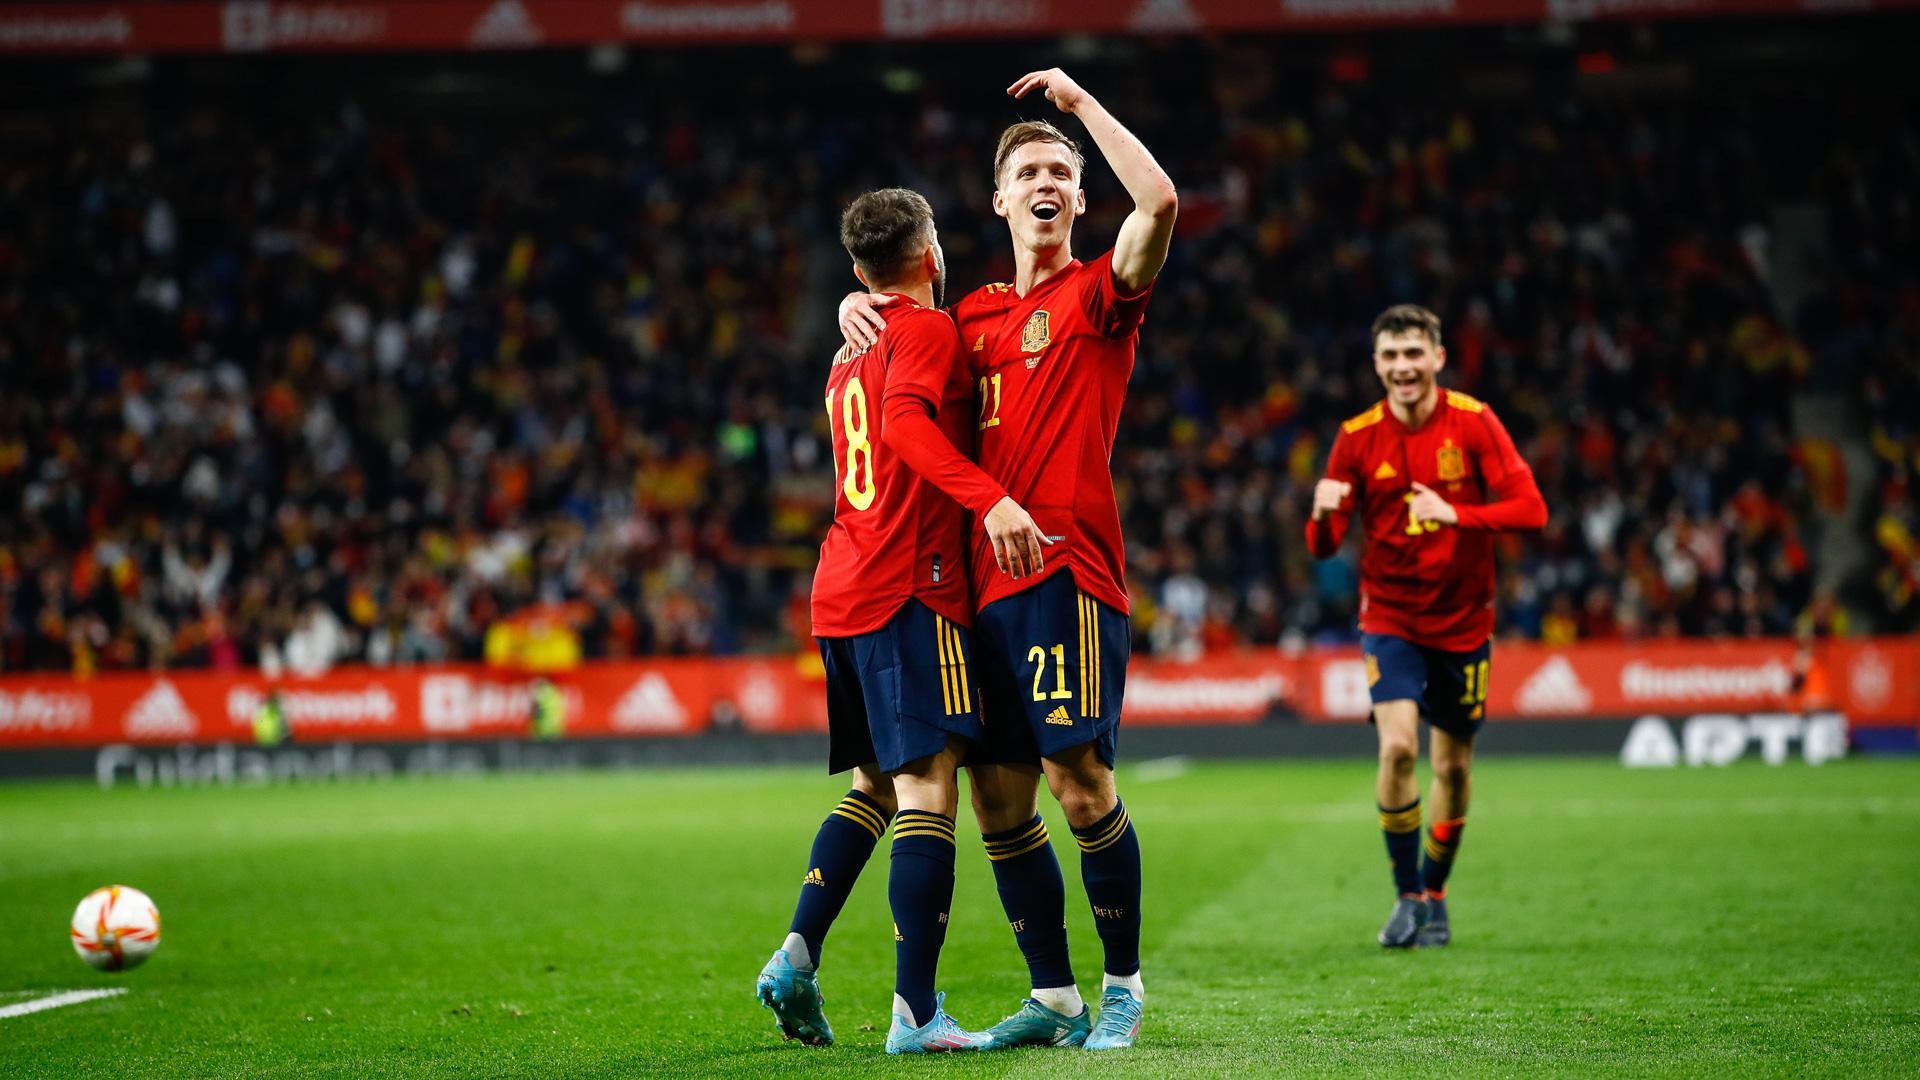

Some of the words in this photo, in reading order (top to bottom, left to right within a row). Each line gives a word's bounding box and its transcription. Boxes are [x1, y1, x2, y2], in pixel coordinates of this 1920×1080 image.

[979, 373, 1001, 430] 21
[825, 377, 876, 511] 18
[1403, 491, 1440, 535] 1
[1027, 644, 1073, 702] 21
[1460, 661, 1489, 704] 10
[1045, 716, 1073, 726] adidas
